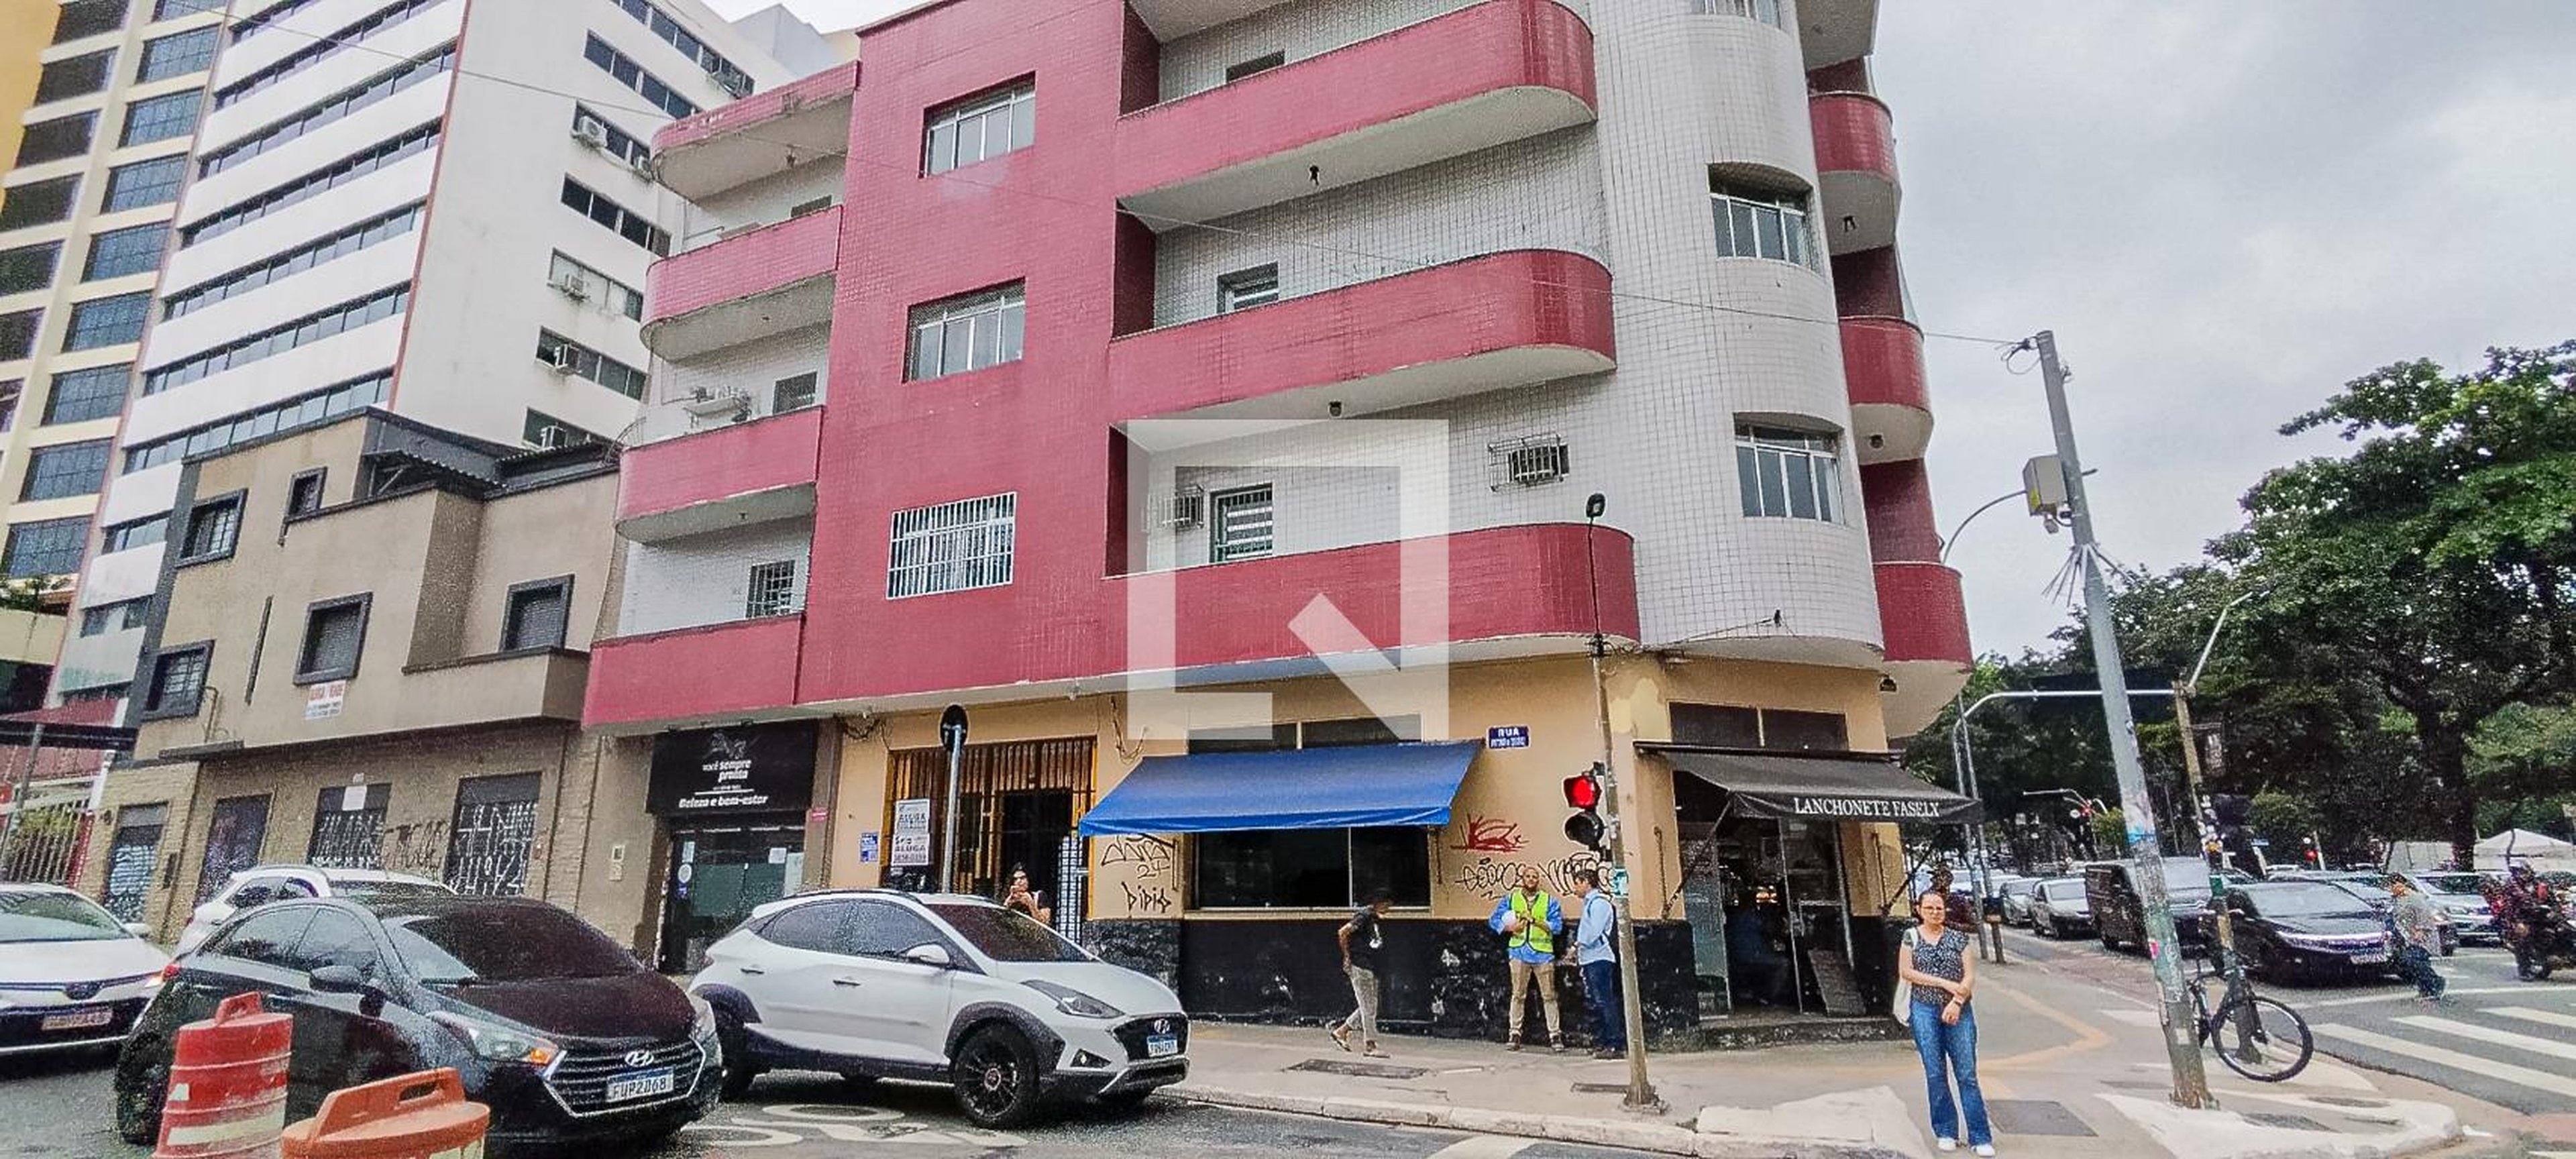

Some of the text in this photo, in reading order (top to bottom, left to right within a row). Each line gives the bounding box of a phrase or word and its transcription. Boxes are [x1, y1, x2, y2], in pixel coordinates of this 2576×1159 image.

[1497, 727, 1520, 737] RUA
[719, 759, 752, 771] sempre
[678, 795, 769, 808] Beleza e bem-estar
[1793, 796, 1940, 818] LANCHONETE FASELX
